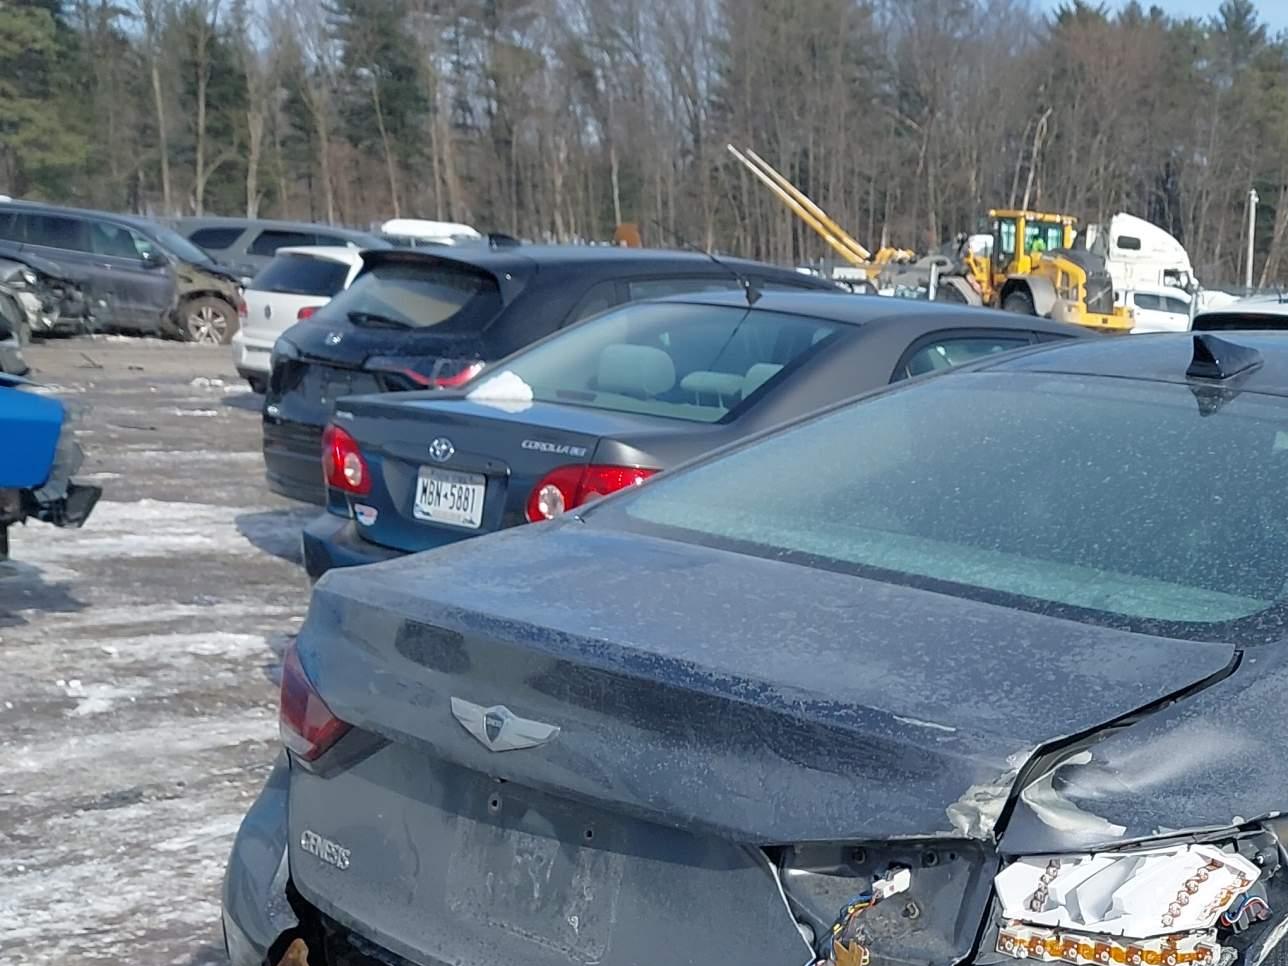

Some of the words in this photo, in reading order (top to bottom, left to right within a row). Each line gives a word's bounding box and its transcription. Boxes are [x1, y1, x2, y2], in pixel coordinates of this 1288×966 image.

[521, 439, 570, 454] COROLLA
[448, 483, 476, 513] 5881
[300, 829, 352, 870] GENESIS
